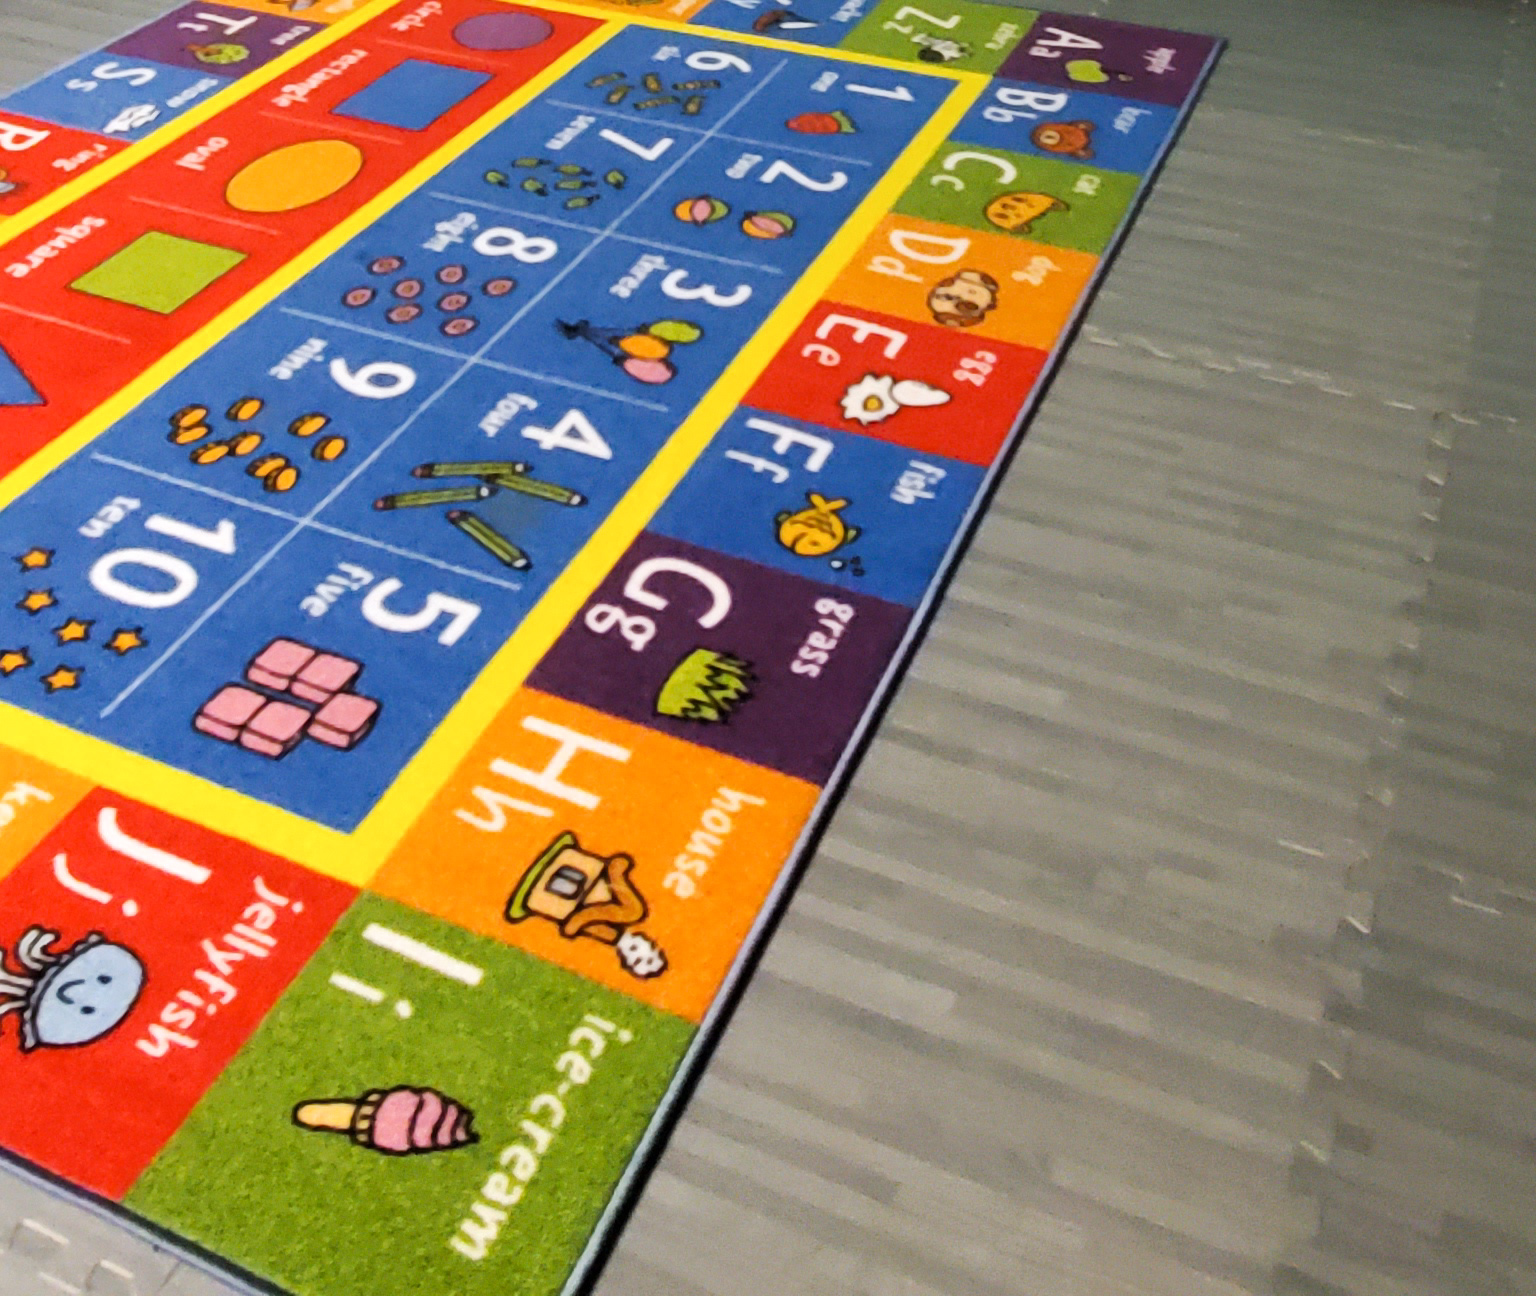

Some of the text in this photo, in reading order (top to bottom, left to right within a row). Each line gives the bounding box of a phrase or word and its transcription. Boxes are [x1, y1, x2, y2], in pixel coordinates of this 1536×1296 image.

[270, 47, 370, 108] rectangle
[684, 50, 754, 75] 6
[844, 81, 916, 104] 1
[174, 135, 231, 172] oval
[599, 127, 675, 162] 7
[759, 158, 849, 194] 2
[3, 214, 109, 281] square
[472, 225, 560, 265] 8
[660, 267, 754, 310] 3
[329, 356, 418, 401] 9
[952, 349, 999, 388] egg
[520, 407, 614, 461] 4
[888, 457, 948, 506] fish
[77, 495, 142, 539] ten
[88, 513, 237, 610] 10
[299, 559, 376, 620] five
[360, 575, 483, 648] 5
[789, 596, 856, 679] grass
[662, 784, 770, 902] house
[136, 874, 308, 1062] jellyfish
[448, 1008, 637, 1266] ice-cream
